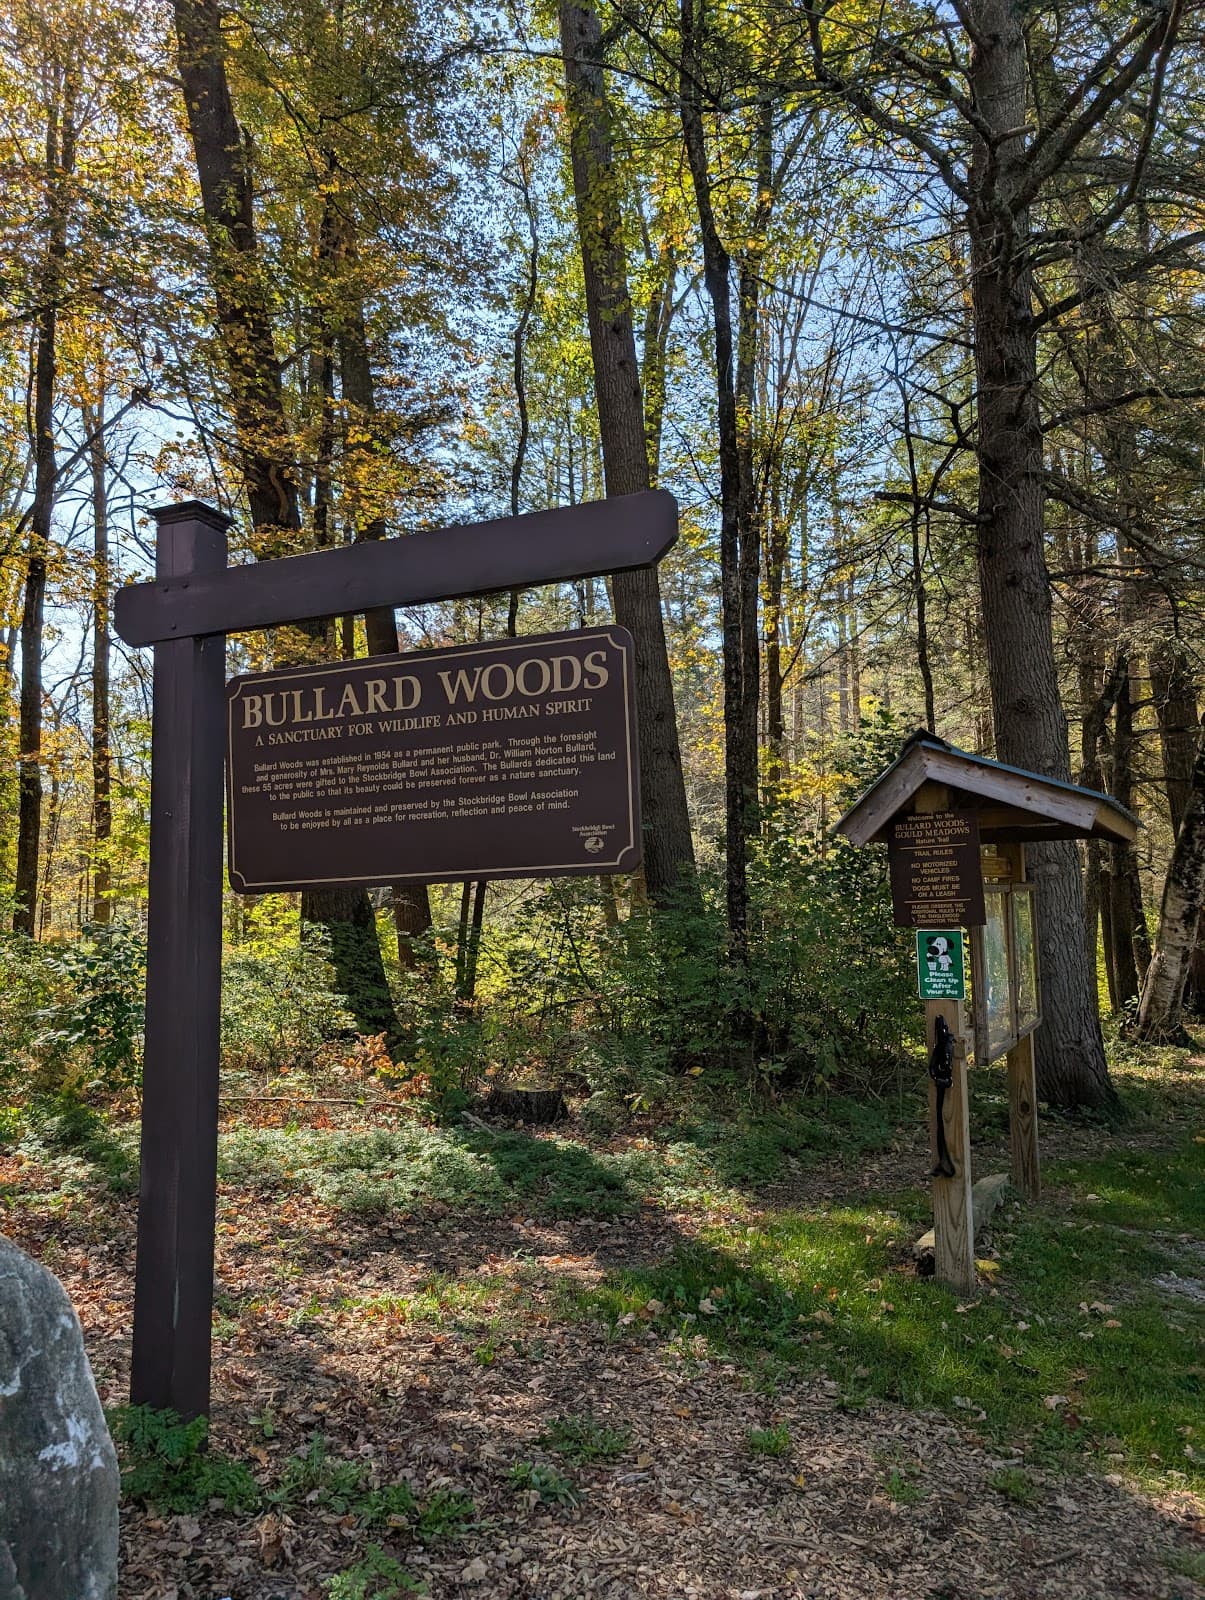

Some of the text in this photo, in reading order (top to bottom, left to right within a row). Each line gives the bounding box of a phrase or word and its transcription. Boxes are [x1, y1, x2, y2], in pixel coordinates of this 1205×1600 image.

[241, 650, 609, 729] BULLARD WOODS
[255, 698, 593, 747] A SANCTUARY FOR WILDLIFE AND HUMAN SPIRIT
[254, 763, 277, 772] Bullard
[279, 761, 303, 770] Woods
[322, 754, 362, 765] established
[374, 751, 391, 760] 1954
[413, 745, 453, 757] permanent
[456, 742, 480, 752] public
[508, 736, 540, 747] Through
[543, 734, 556, 744] the
[560, 730, 597, 742] foresight
[256, 774, 269, 782] and
[270, 770, 307, 782] generosity
[337, 765, 355, 775] Mary
[357, 762, 390, 772] Reynolds
[392, 759, 418, 769] Bullard
[421, 757, 434, 766] and
[437, 755, 450, 764] her
[503, 748, 532, 758] William
[534, 746, 563, 756] Norton
[241, 785, 260, 793] these
[262, 783, 272, 791] 55
[296, 780, 312, 788] were
[315, 778, 336, 788] gifted
[362, 771, 406, 782] Stockbridge
[409, 769, 428, 778] Bowl
[482, 762, 498, 771] The
[500, 759, 532, 770] Bullards
[535, 755, 576, 766] dedicated
[579, 754, 595, 762] this
[598, 752, 616, 760] land
[279, 792, 291, 800] the
[292, 790, 314, 800] public
[355, 784, 380, 794] beauty
[382, 782, 403, 791] could
[405, 781, 416, 789] be
[418, 776, 456, 787] preserved
[459, 775, 486, 784] forever
[509, 771, 535, 780] nature
[272, 811, 296, 820] Bullard
[298, 809, 322, 819] Woods
[334, 805, 372, 816] maintained
[374, 804, 388, 812] and
[390, 800, 428, 812] preserved
[430, 800, 441, 809] by
[443, 798, 455, 807] the
[458, 794, 505, 806] Stockbridge
[508, 792, 528, 801] Bowl
[530, 789, 579, 800] Association
[290, 821, 299, 830] be
[302, 819, 330, 830] enjoyed
[332, 818, 341, 828] by
[343, 818, 352, 826] all
[372, 814, 392, 825] place
[395, 813, 406, 822] for
[451, 807, 488, 817] reflection
[490, 805, 505, 814] and
[508, 804, 533, 814] peace
[536, 802, 544, 811] of
